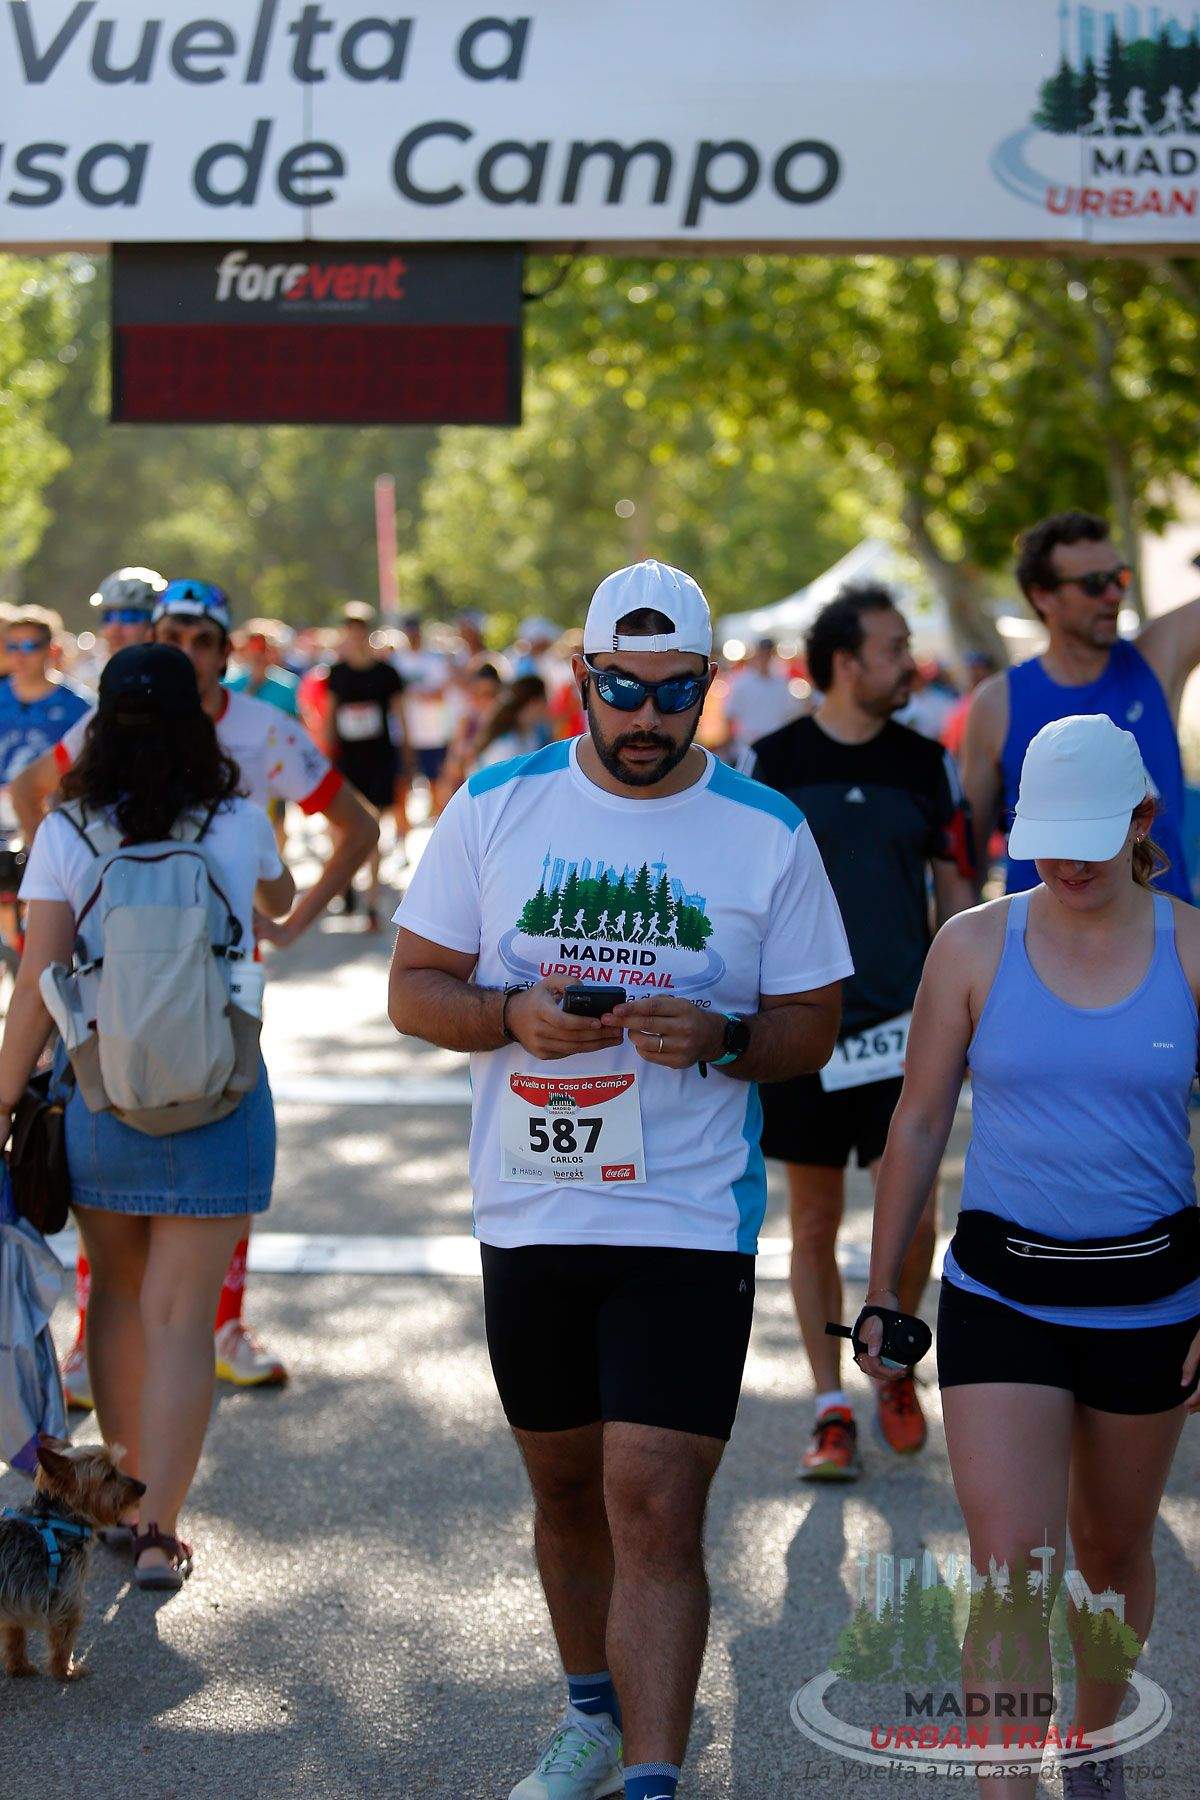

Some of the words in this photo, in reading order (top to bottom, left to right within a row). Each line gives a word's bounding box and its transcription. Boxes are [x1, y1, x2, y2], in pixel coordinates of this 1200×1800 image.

[10, 0, 415, 85] Vuelta
[457, 16, 533, 83] a
[0, 141, 152, 207] sa
[193, 119, 346, 207] de
[393, 121, 841, 228] Campo
[1044, 186, 1199, 218] URBAN
[216, 250, 406, 302] forevent
[559, 943, 657, 966] MADRID
[539, 962, 613, 983] URBAN
[618, 969, 675, 989] TRAIL
[837, 1028, 905, 1064] 1267
[520, 1079, 539, 1089] Vuelta
[547, 1082, 554, 1090] la
[558, 1083, 579, 1091] Casa
[581, 1082, 593, 1090] de
[595, 1080, 628, 1089] Campo
[529, 1117, 603, 1153] 587
[519, 1168, 543, 1177] MADRID
[550, 1156, 584, 1164] CARLOS
